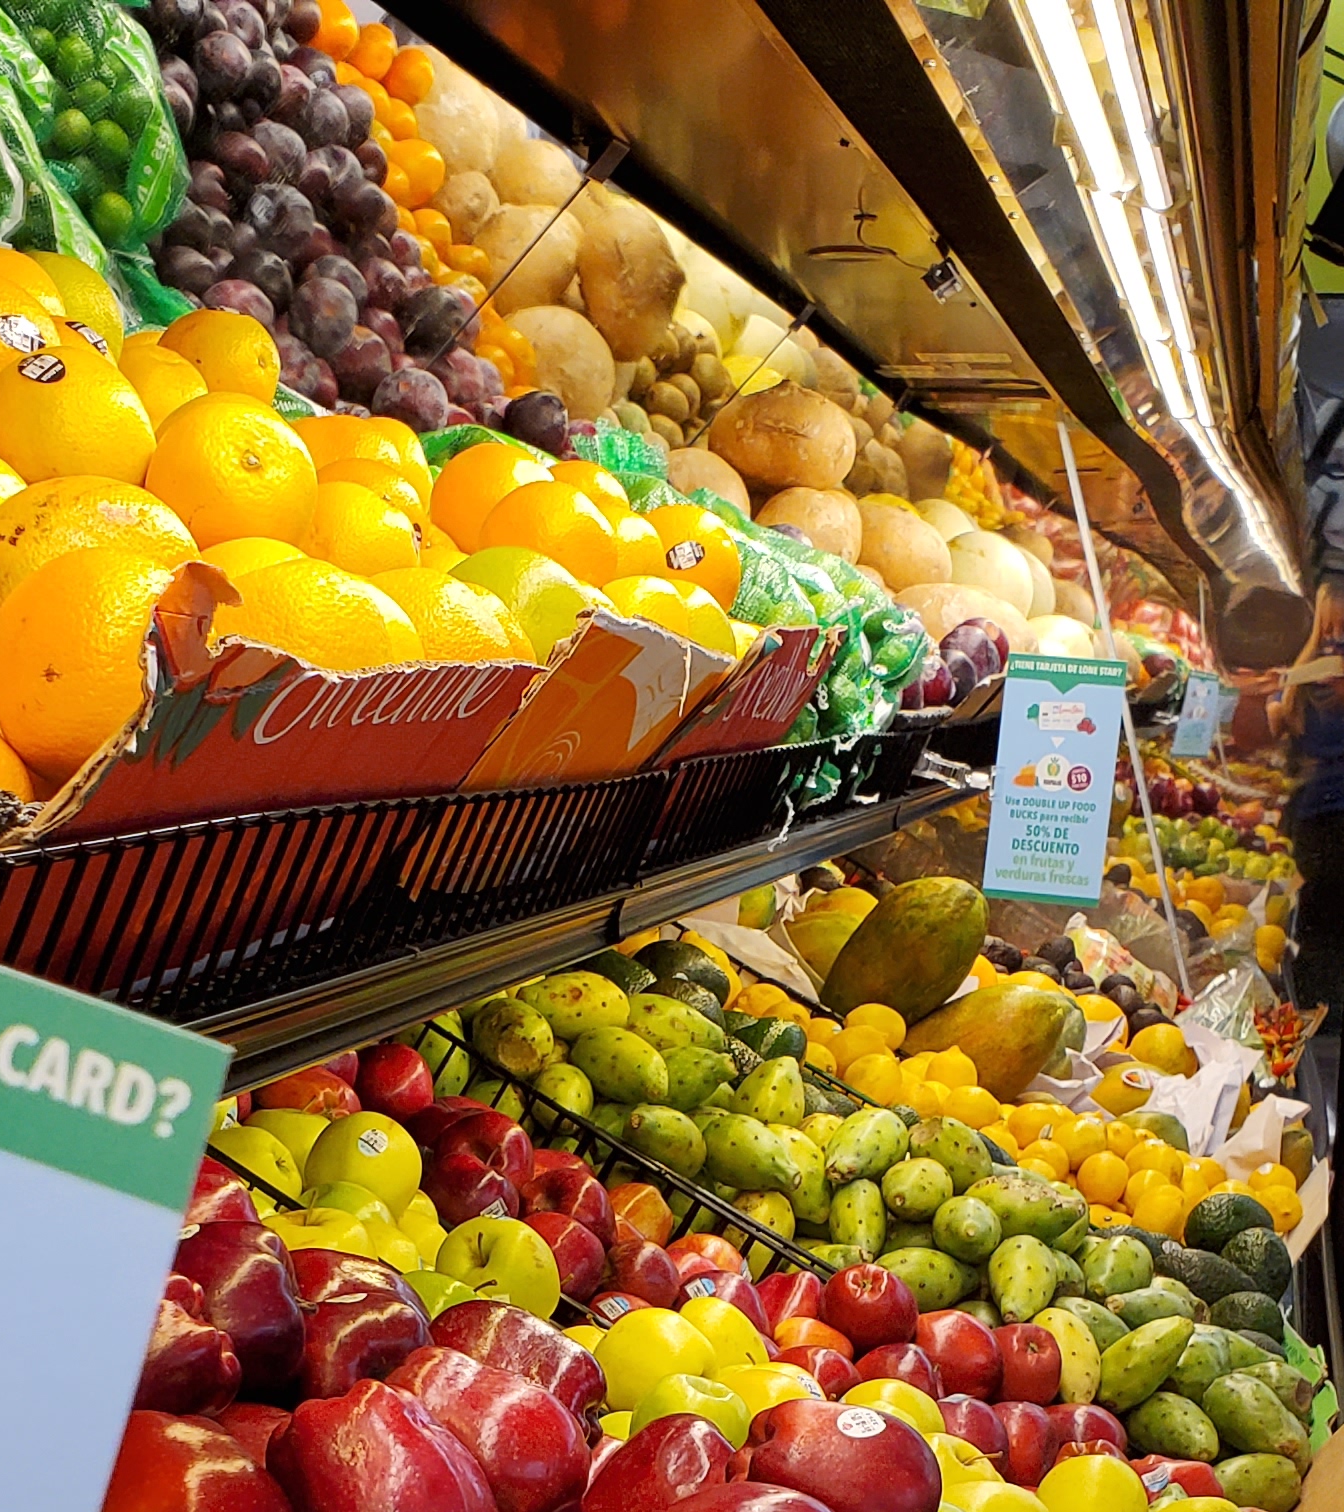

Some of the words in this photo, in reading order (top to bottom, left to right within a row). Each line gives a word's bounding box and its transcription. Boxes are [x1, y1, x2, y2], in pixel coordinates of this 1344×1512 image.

[1036, 661, 1066, 672] TARJETA
[1079, 664, 1098, 675] LONE
[1100, 666, 1122, 677] STAR?
[1022, 798, 1056, 809] DOUBLE
[1058, 801, 1070, 810] UP
[1072, 802, 1096, 812] FOOD
[1010, 809, 1038, 820] BUCKS
[1040, 813, 1058, 823] para
[1026, 825, 1050, 838] 50%
[1054, 828, 1069, 840] DE
[1011, 838, 1080, 856] DESCUENTO
[1013, 855, 1027, 866] en
[1030, 854, 1064, 870] frutas
[995, 867, 1046, 883] verduras
[1049, 869, 1090, 886] frescas
